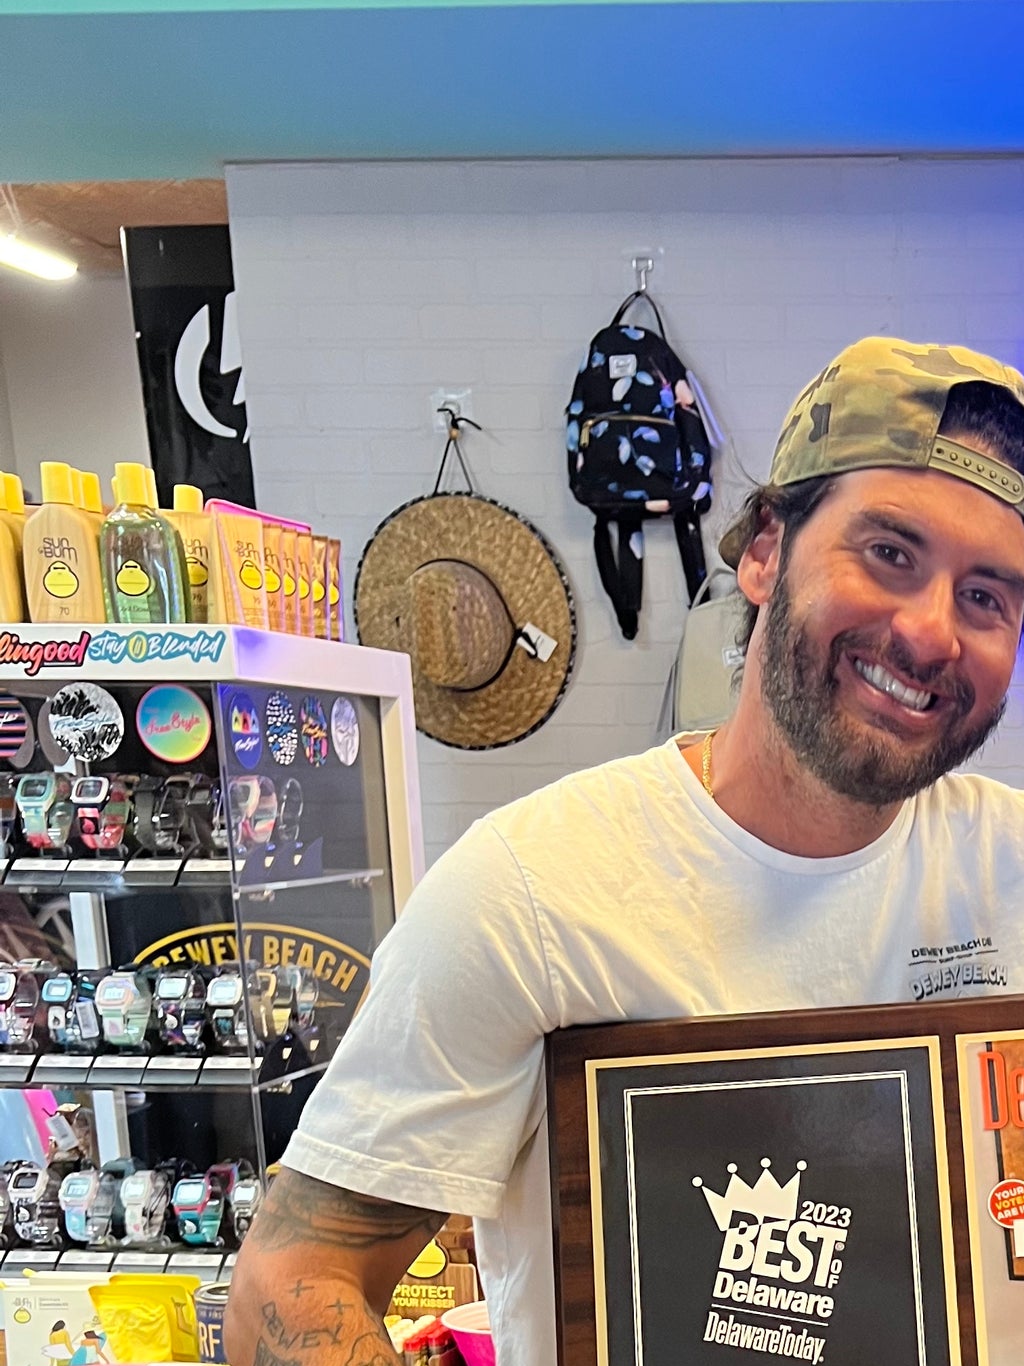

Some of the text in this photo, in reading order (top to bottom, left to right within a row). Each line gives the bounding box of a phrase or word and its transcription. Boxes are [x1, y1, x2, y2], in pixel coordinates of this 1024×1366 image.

[0, 631, 91, 676] lingood
[89, 630, 221, 662] Stay Blended
[262, 934, 359, 993] BEACH
[911, 946, 945, 958] DEWEY
[946, 939, 981, 955] BEACH
[909, 963, 1008, 1001] DEWEY BEACH
[994, 1185, 1024, 1201] YOUR
[799, 1200, 852, 1228] 2023
[996, 1206, 1018, 1220] ARE
[718, 1209, 848, 1288] BEST
[827, 1258, 843, 1289] OF
[392, 1298, 456, 1309] YOUR KISSER
[393, 1284, 455, 1299] PROTECT
[712, 1270, 835, 1319] Delaware
